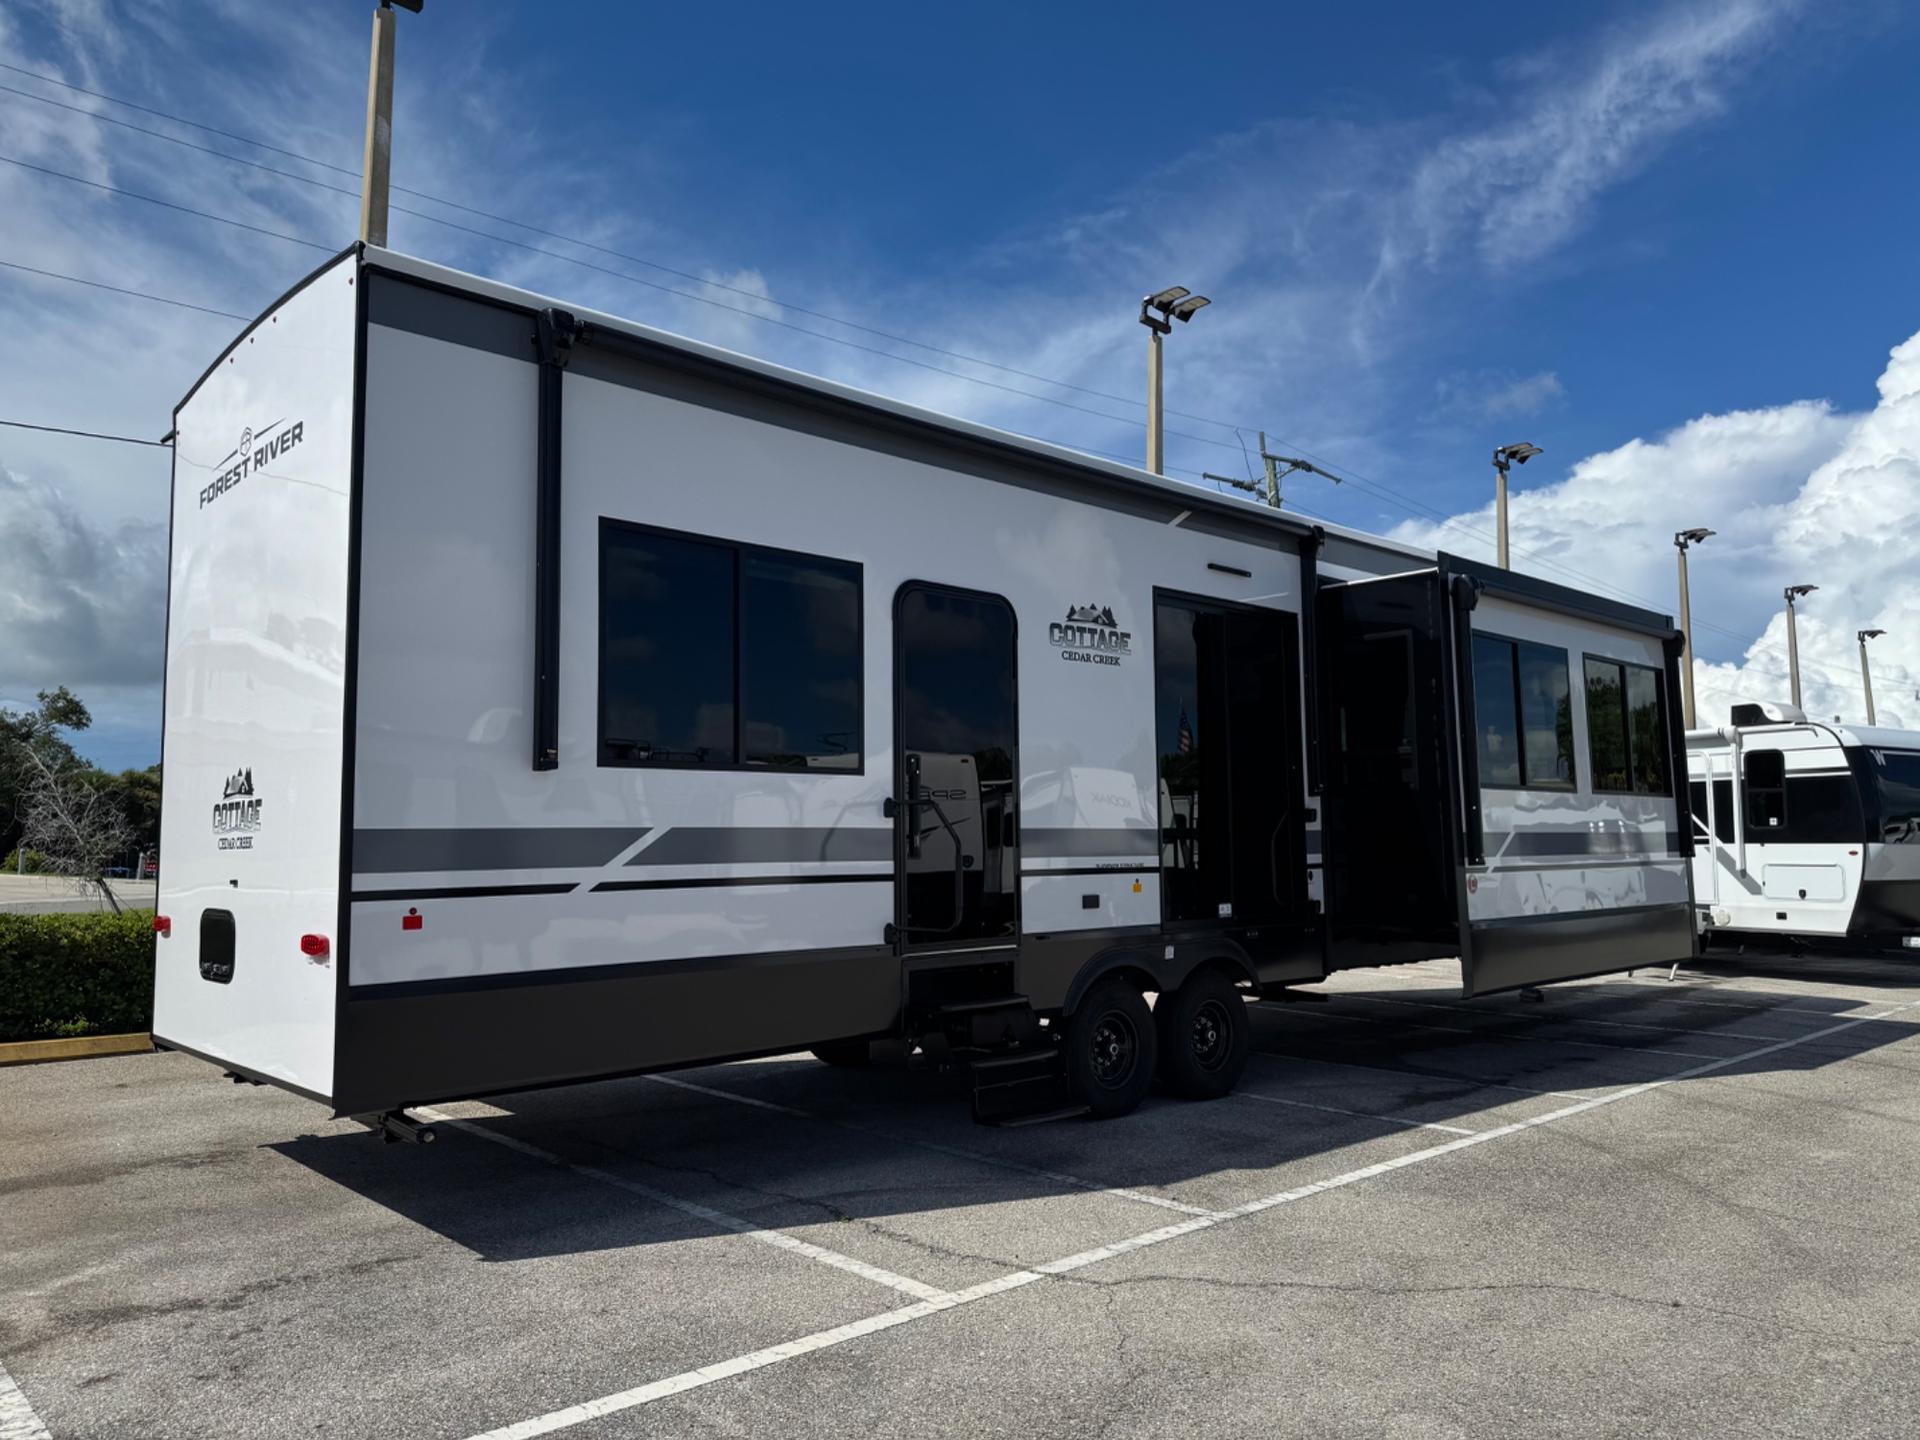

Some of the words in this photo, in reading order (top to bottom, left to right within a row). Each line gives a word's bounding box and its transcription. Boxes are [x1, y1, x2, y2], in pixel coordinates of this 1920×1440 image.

[199, 456, 251, 510] FOREST
[253, 420, 303, 472] RIVER
[1049, 621, 1133, 656] COTTAGE
[1061, 650, 1092, 663] CEDAR
[1093, 654, 1121, 667] CREEK
[213, 798, 263, 834] COTTAGE
